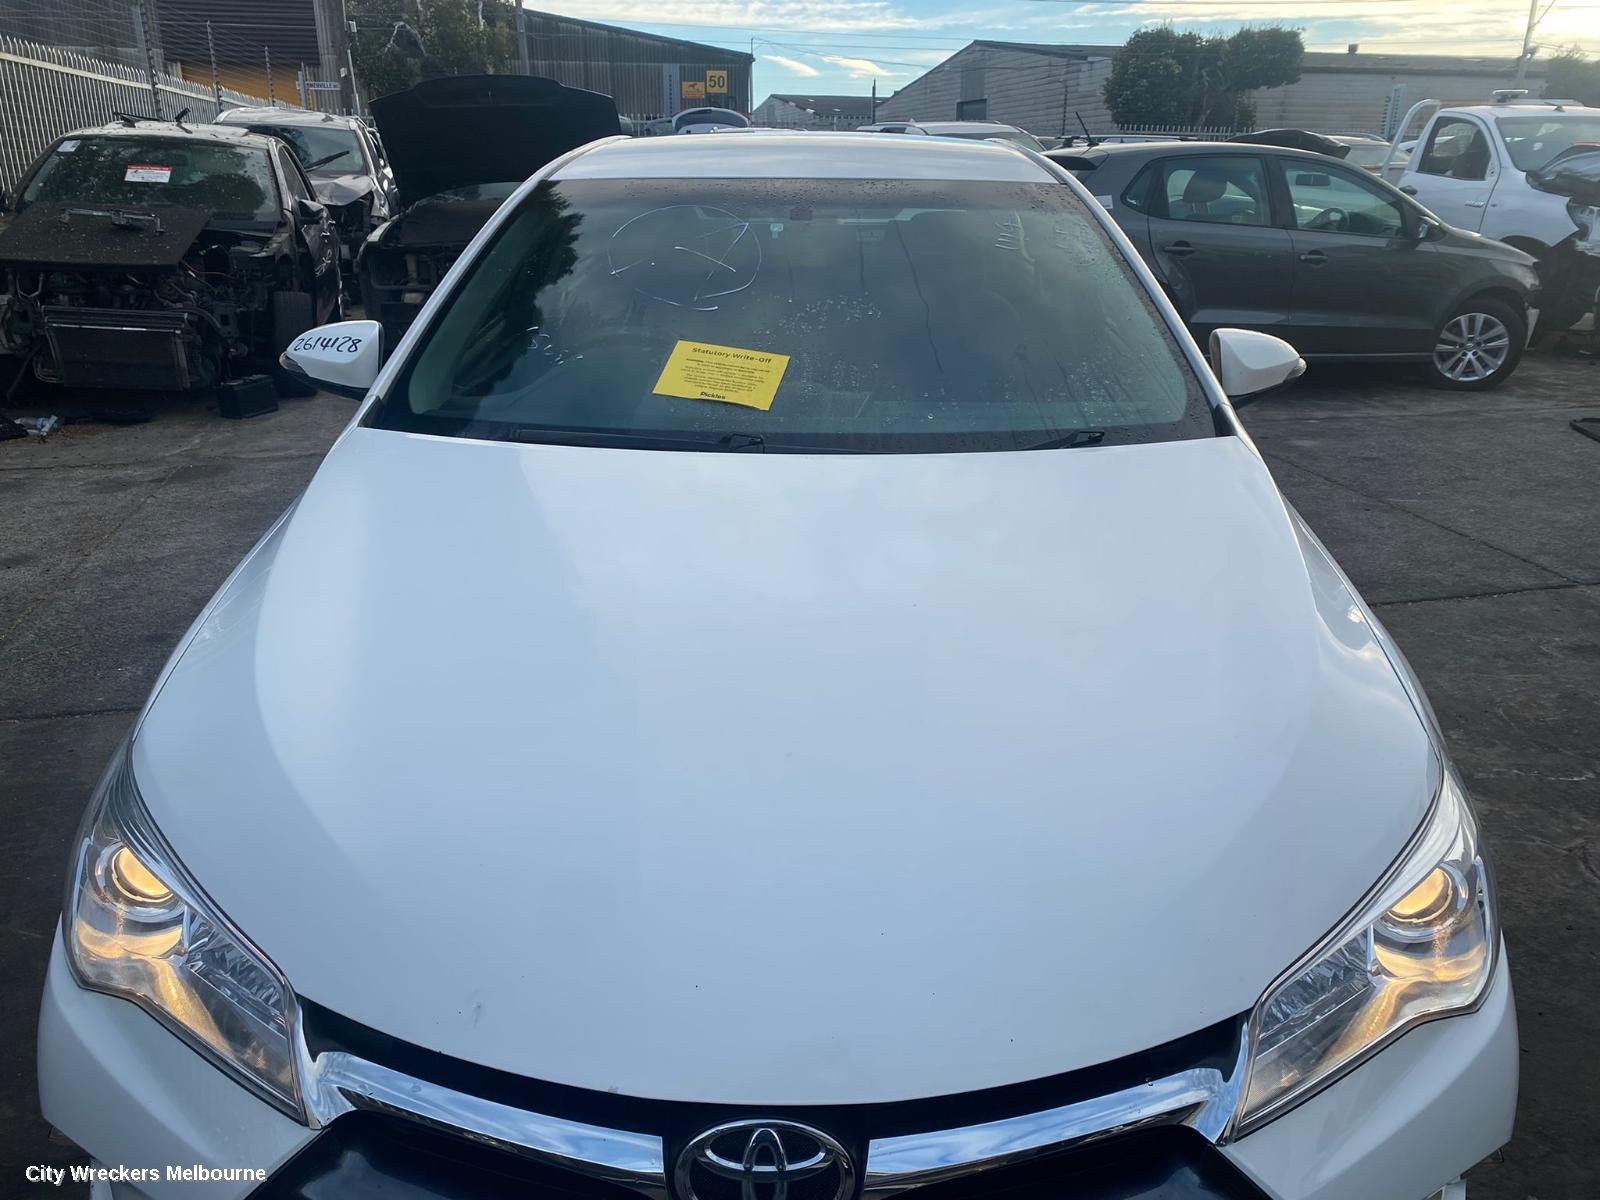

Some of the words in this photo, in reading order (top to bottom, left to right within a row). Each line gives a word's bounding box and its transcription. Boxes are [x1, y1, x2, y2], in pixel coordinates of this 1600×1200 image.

[709, 75, 725, 88] 50
[692, 347, 730, 358] Statutory
[732, 353, 772, 364] Write-Off
[700, 391, 726, 400] Pickles
